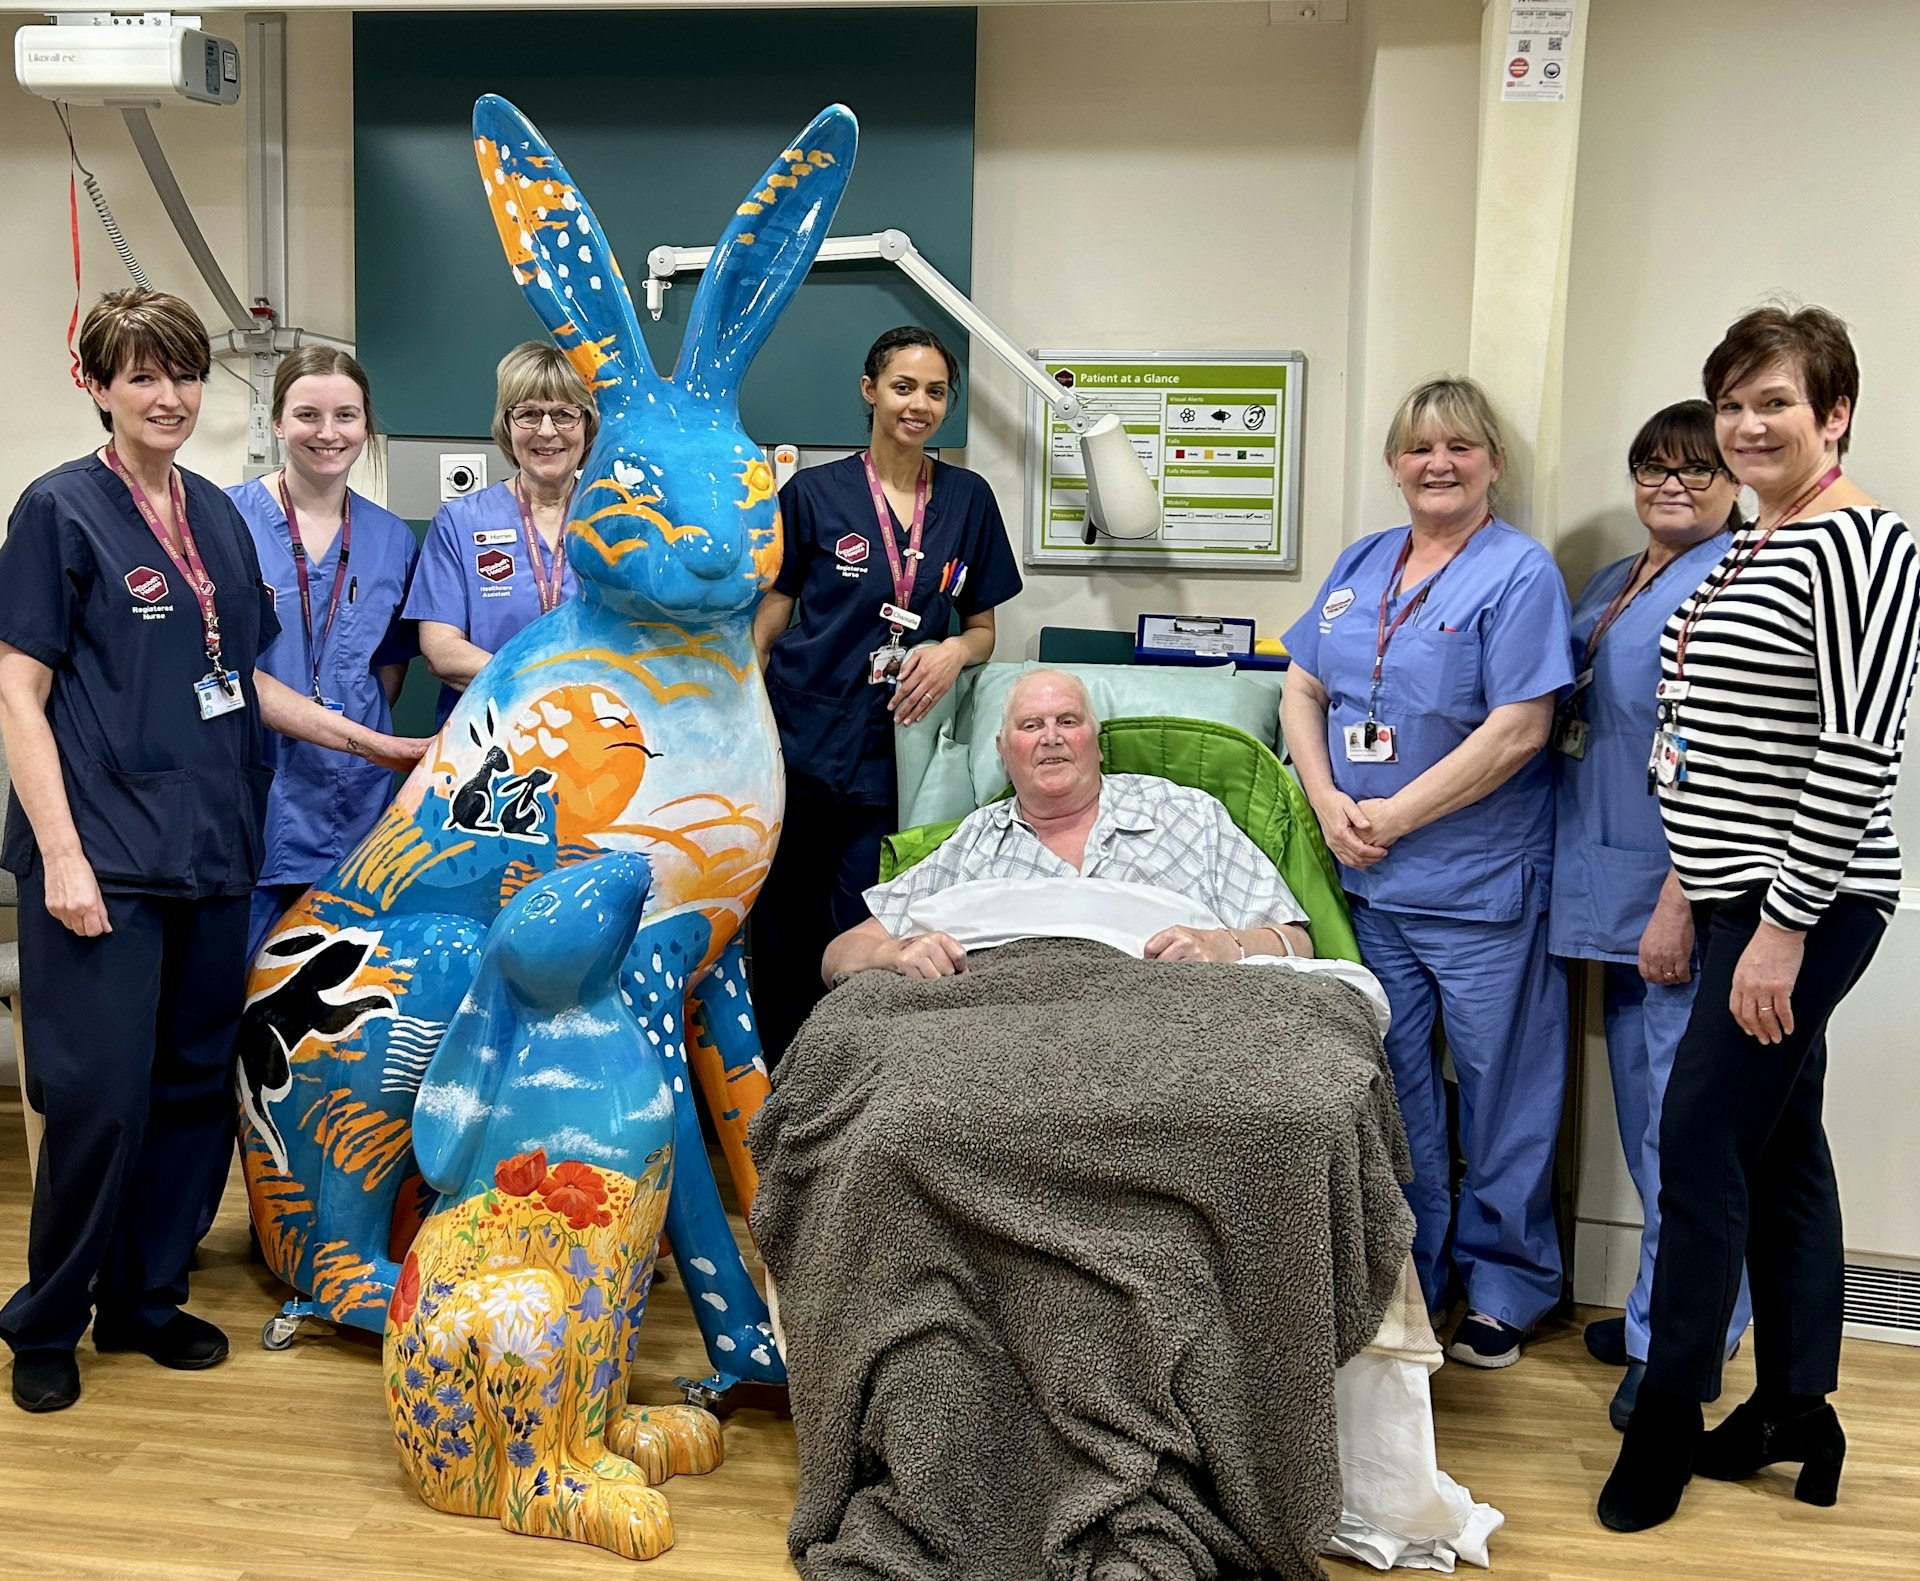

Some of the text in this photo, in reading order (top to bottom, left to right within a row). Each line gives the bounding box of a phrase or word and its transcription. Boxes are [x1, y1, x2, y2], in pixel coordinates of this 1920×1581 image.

[1080, 373, 1118, 384] Patient
[1120, 375, 1129, 384] at
[1144, 374, 1180, 384] Glance
[866, 463, 876, 483] NURSE
[140, 500, 158, 524] NURSE
[874, 493, 885, 514] NURSE
[883, 525, 893, 548] NURSE
[913, 522, 922, 544] NURSE
[162, 536, 180, 560] NURSE
[183, 535, 196, 558] NURSE
[836, 563, 869, 573] Registered
[891, 559, 901, 582] NURSE
[132, 605, 174, 614] Registered
